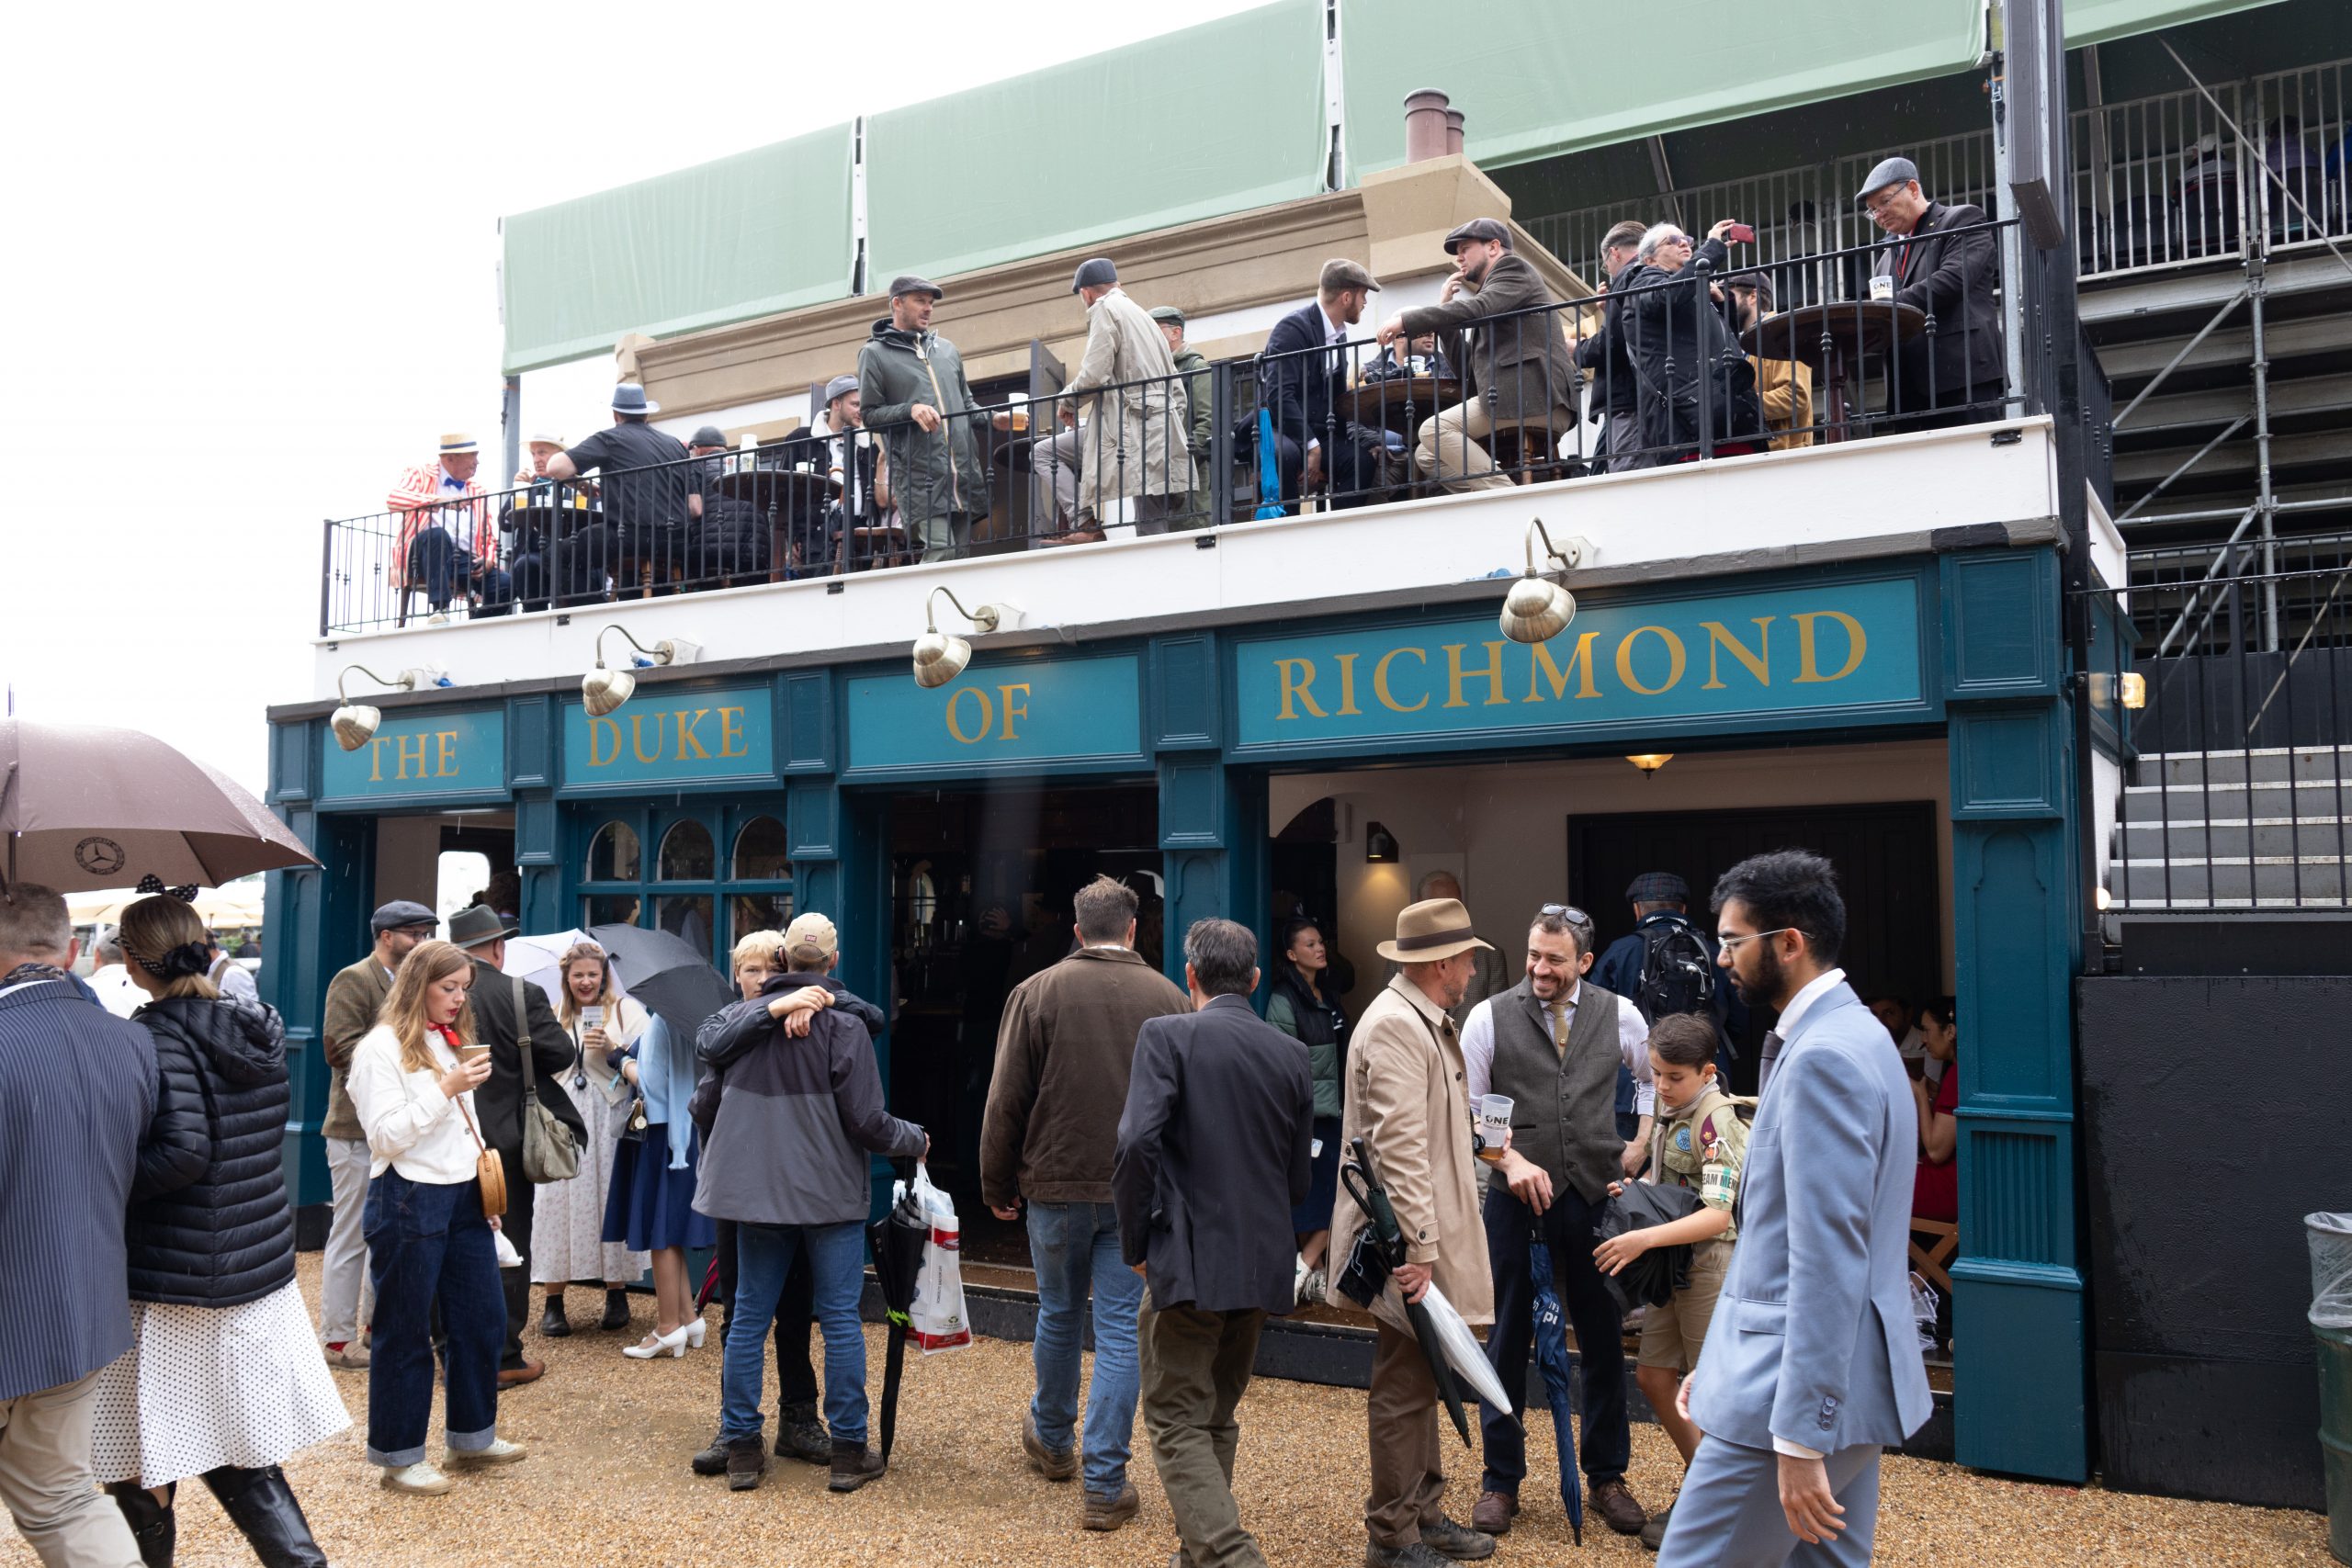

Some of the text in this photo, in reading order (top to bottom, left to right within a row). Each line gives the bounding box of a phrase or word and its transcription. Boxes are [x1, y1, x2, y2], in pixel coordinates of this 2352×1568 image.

[368, 610, 1869, 782] THE DUKE OF RICHMOND
